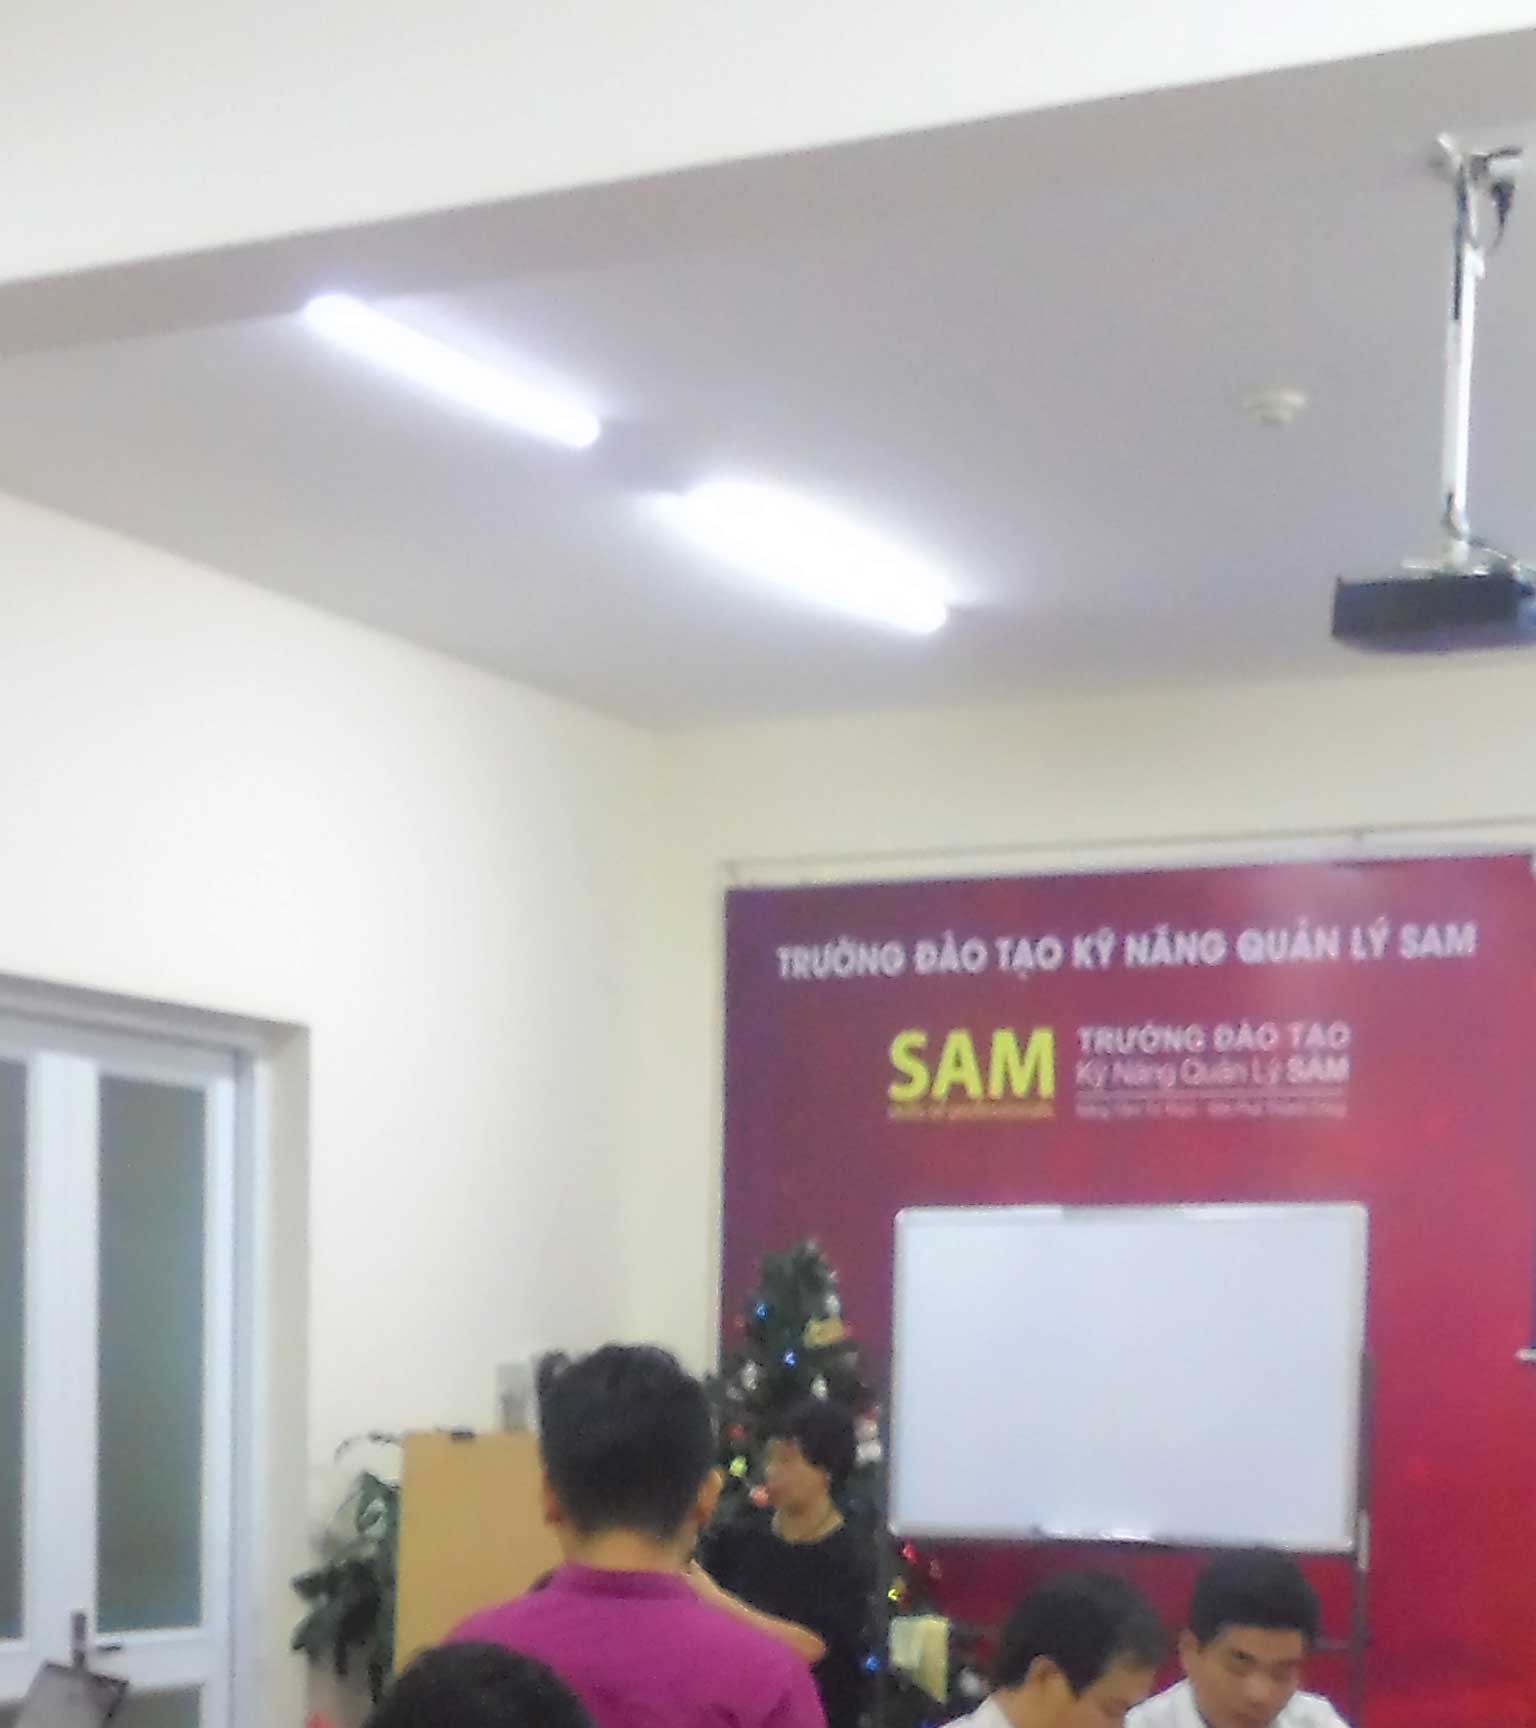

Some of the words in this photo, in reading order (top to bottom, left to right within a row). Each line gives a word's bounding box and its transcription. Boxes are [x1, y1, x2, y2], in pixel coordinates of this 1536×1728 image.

[996, 934, 1062, 981] TẠO
[1350, 915, 1390, 961] LÝ
[1400, 919, 1478, 960] SAM
[888, 1028, 1056, 1101] SAM
[1285, 1054, 1351, 1084] SAM
